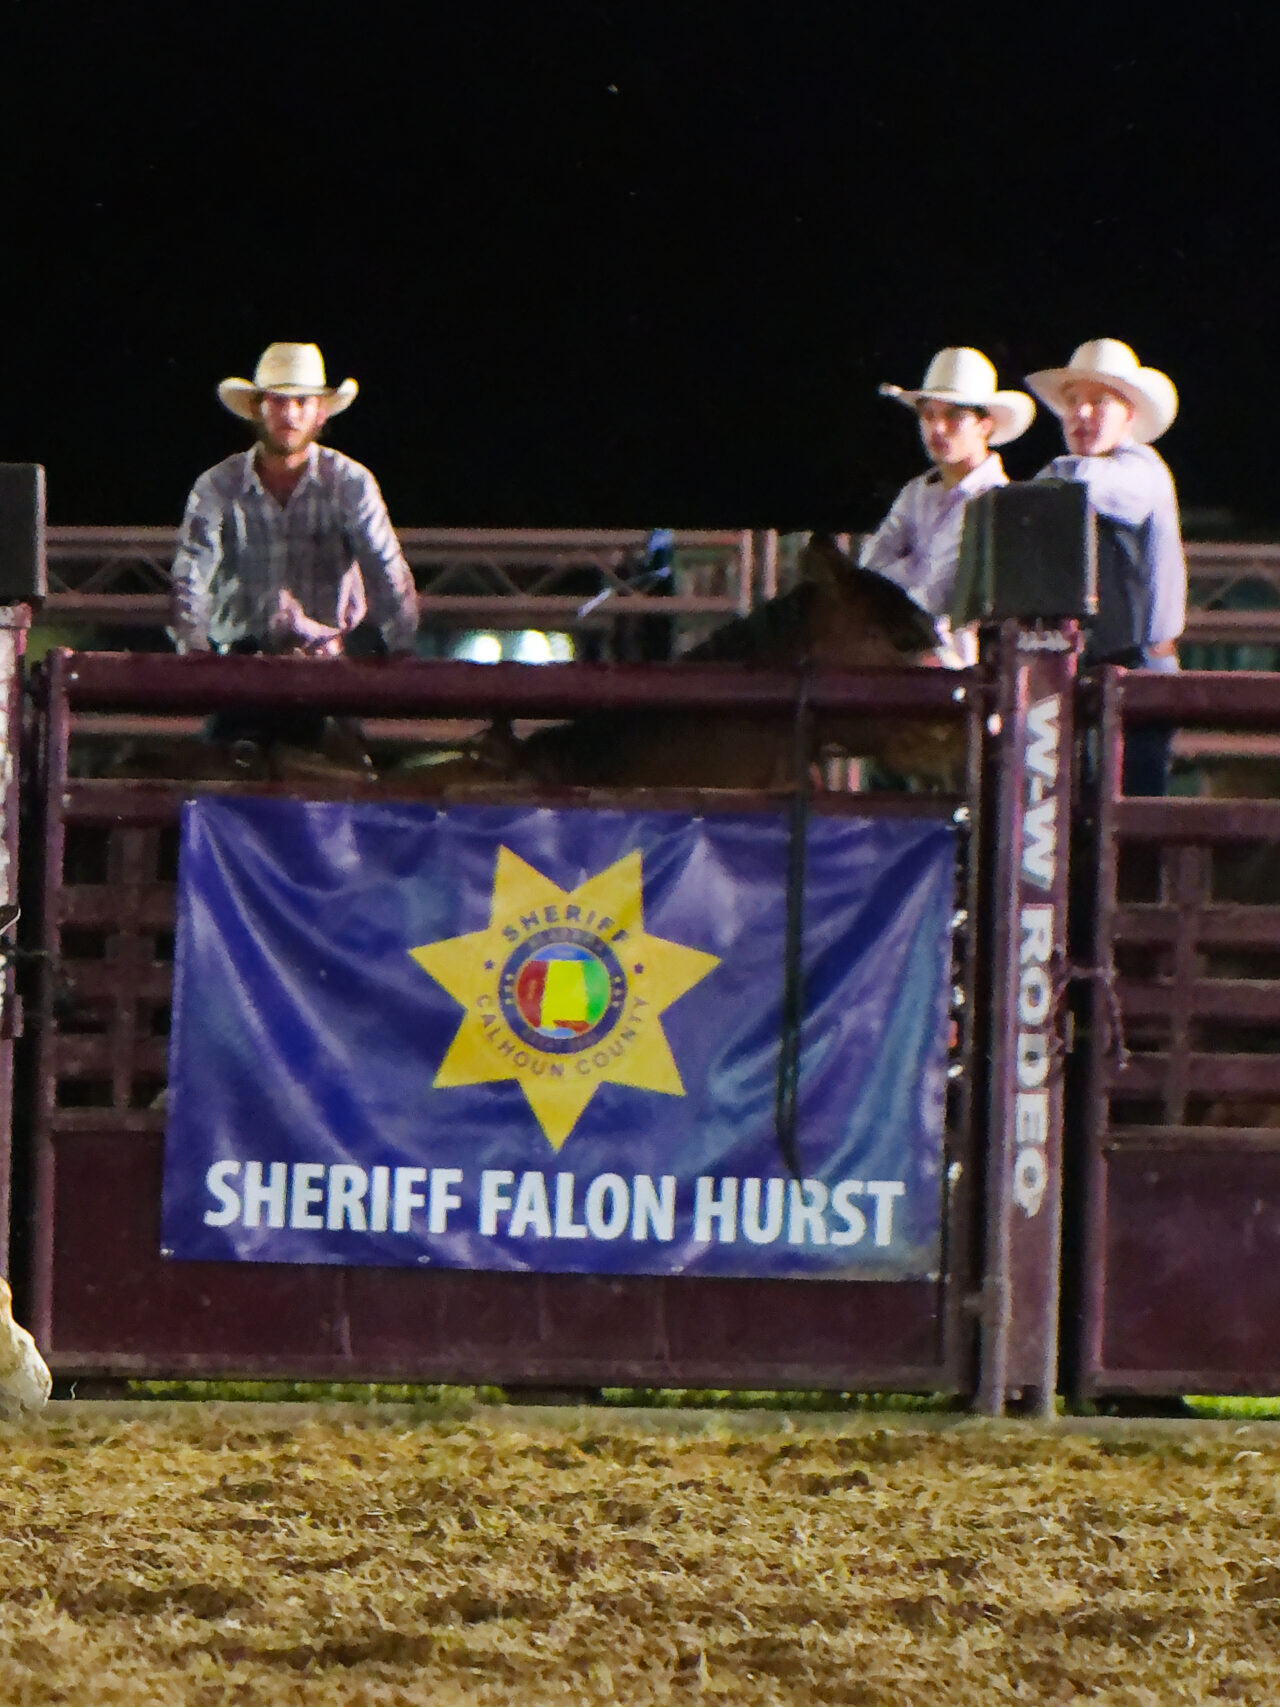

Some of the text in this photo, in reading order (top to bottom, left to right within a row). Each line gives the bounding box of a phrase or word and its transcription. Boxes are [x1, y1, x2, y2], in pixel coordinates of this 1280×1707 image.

[1023, 693, 1062, 891] W-W
[501, 904, 629, 943] SHERIFF
[476, 994, 648, 1077] CALHOUN COUNTY
[1013, 903, 1056, 1217] RODEO
[203, 1159, 907, 1249] SHERIFF FALON HURST
